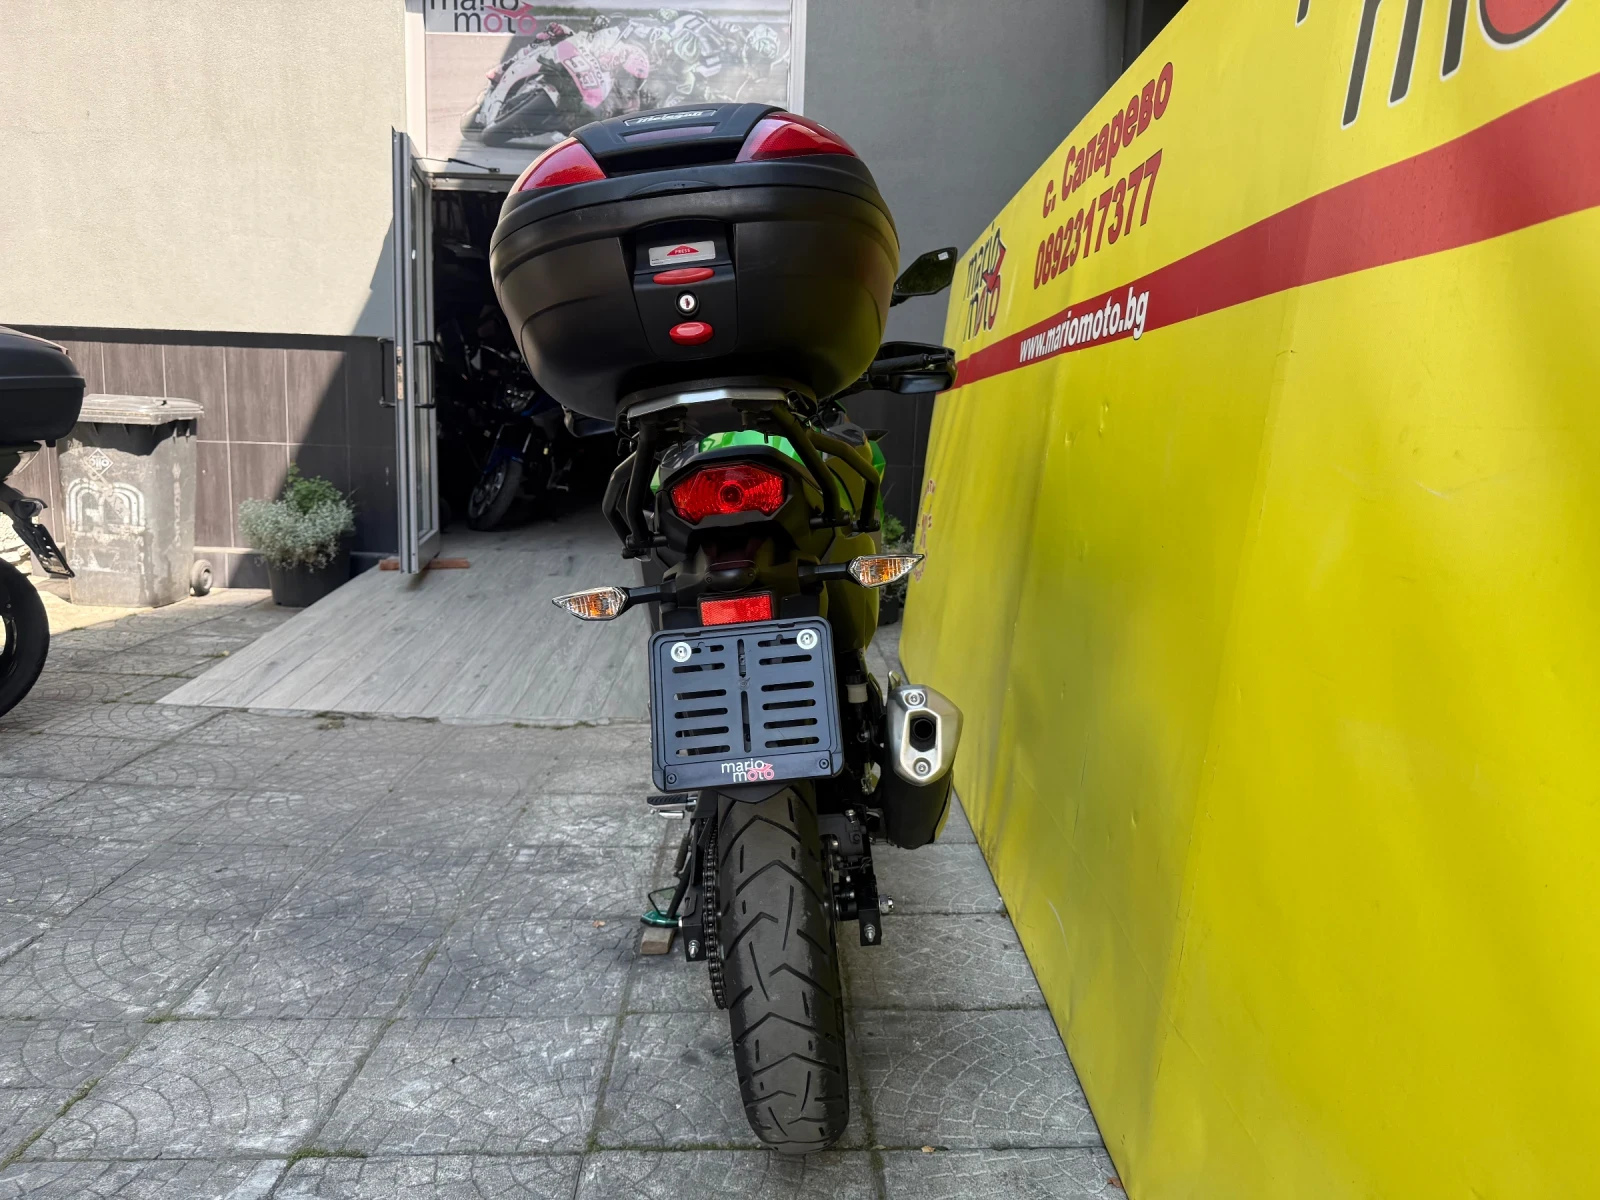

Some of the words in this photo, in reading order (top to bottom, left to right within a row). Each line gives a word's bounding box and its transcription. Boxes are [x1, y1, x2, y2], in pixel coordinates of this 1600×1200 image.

[1061, 62, 1174, 202] Сапарево
[1033, 148, 1163, 290] 0892317377
[1019, 286, 1150, 363] www.mariomoto.bg
[721, 758, 764, 774] mario
[732, 768, 775, 783] moto
